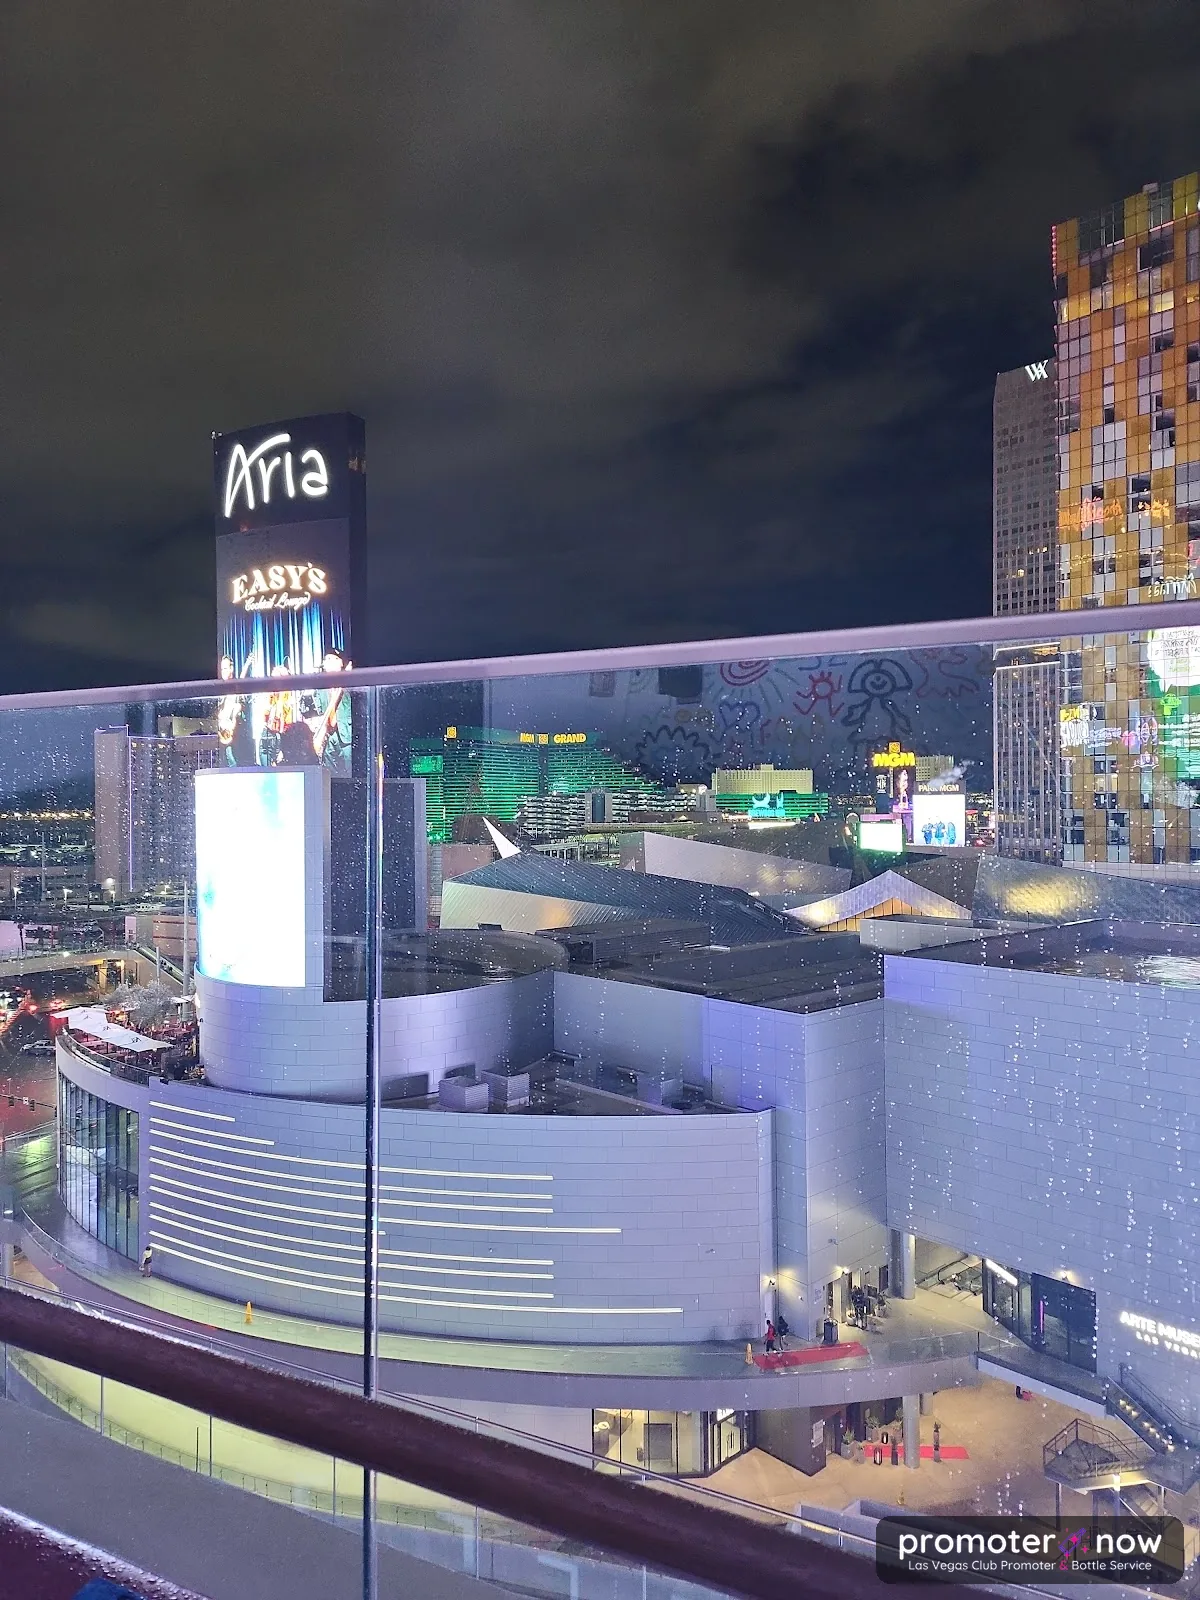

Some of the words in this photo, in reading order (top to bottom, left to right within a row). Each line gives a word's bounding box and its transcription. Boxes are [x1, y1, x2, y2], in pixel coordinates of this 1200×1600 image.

[224, 433, 330, 518] Aria
[231, 562, 327, 604] EASY'S
[554, 734, 586, 743] GRAND
[873, 752, 915, 767] MGM
[1120, 1311, 1156, 1333] ARTE
[1164, 1341, 1200, 1359] VEGA
